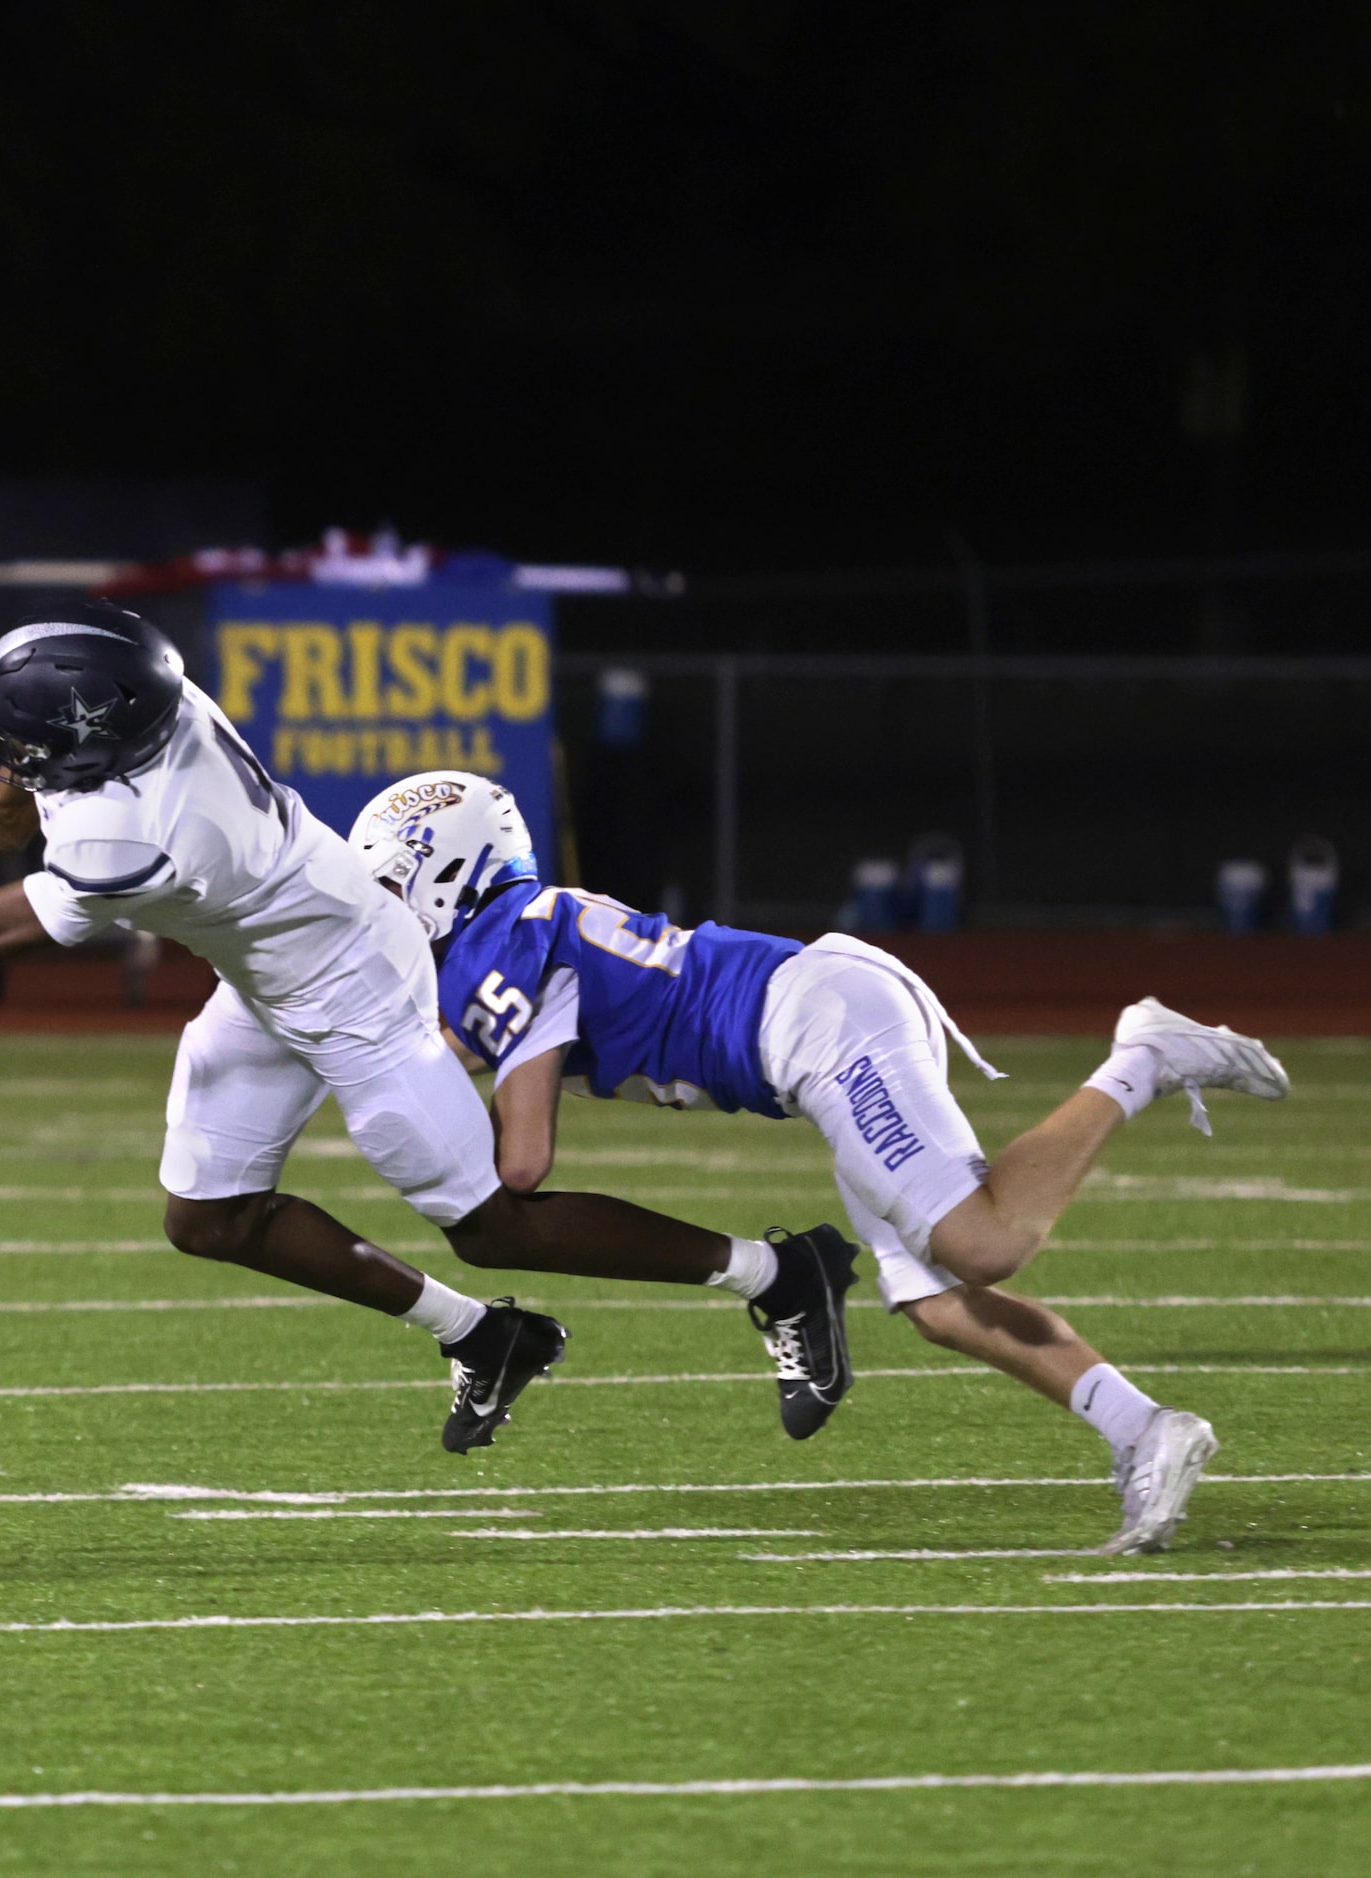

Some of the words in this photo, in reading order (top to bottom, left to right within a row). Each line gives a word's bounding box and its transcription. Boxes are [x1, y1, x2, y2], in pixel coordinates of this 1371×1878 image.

[218, 621, 551, 720] FRISCO
[273, 728, 501, 776] FOOTBALL
[462, 970, 533, 1057] 25
[835, 1055, 925, 1172] RACCOONS
